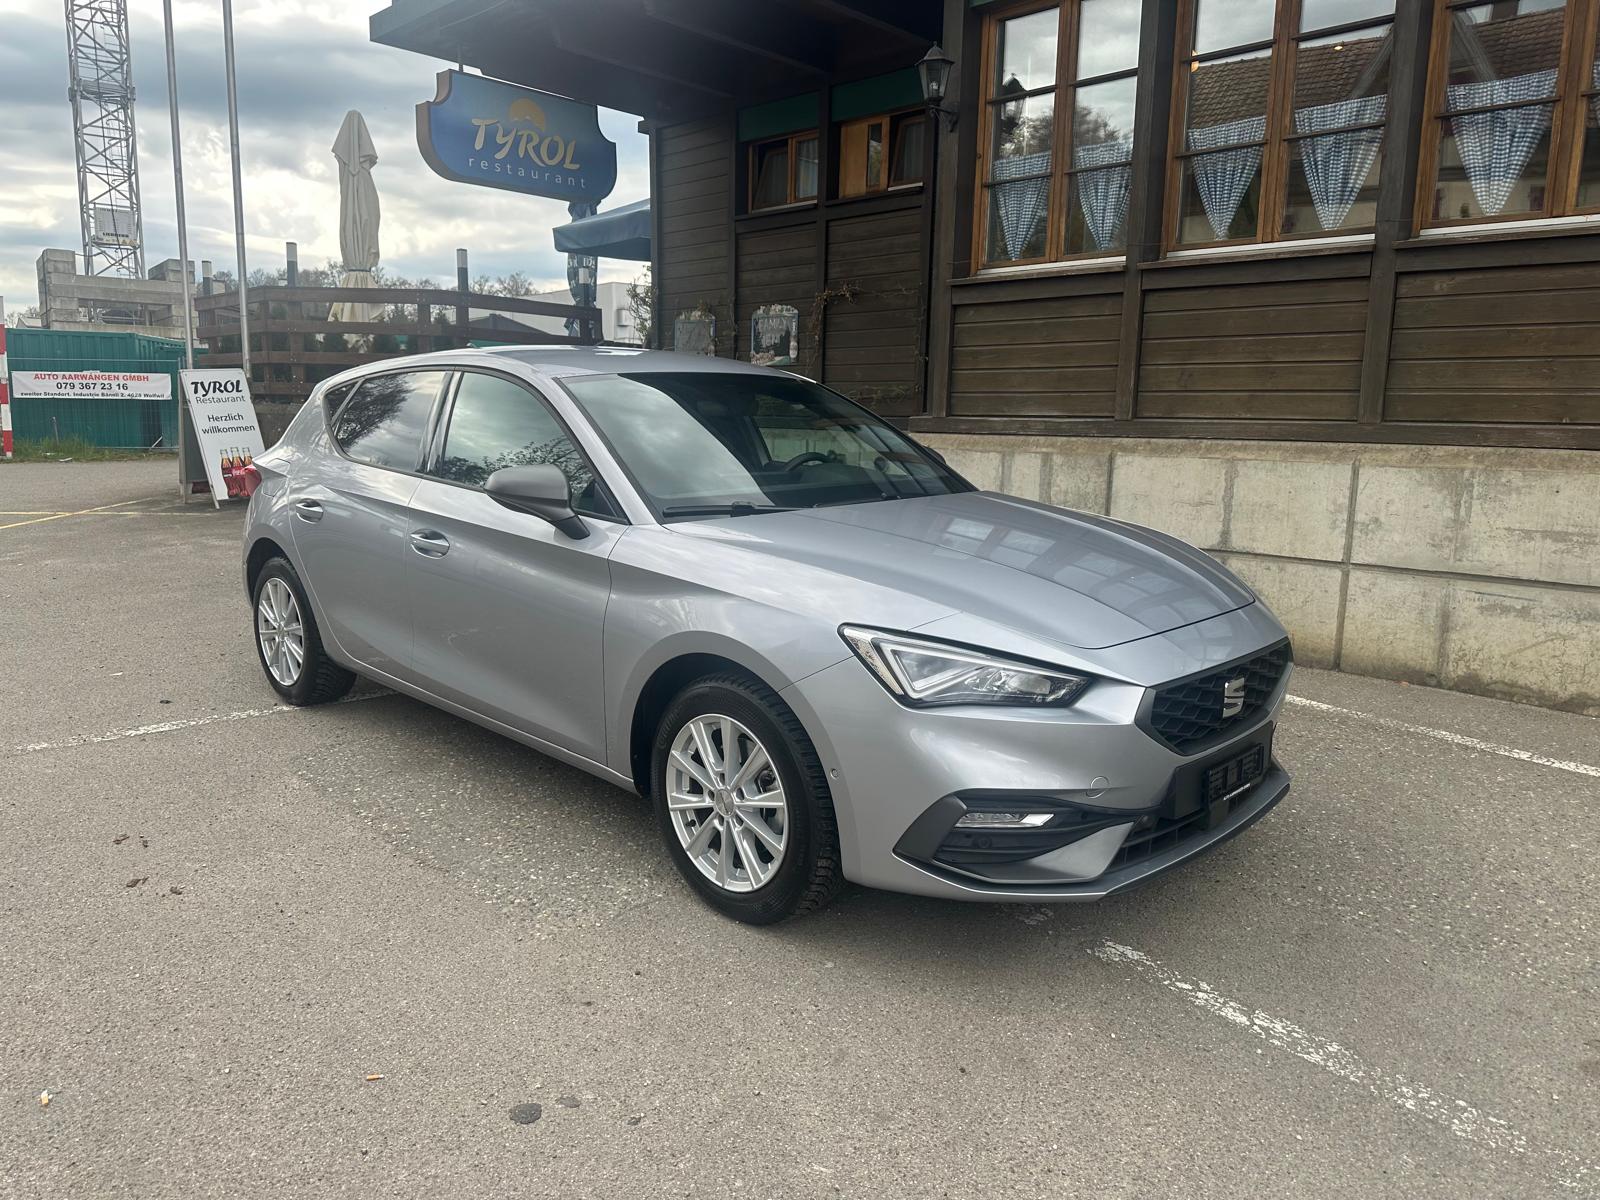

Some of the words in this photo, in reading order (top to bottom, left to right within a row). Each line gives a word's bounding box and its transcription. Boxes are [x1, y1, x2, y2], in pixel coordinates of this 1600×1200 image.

[471, 117, 581, 170] TYROL
[468, 156, 587, 189] restaurant
[33, 373, 59, 381] AUTO
[61, 373, 120, 382] AARWANGEN
[122, 374, 149, 382] GMBH
[56, 382, 76, 390] 079
[78, 382, 97, 390] 367
[100, 382, 113, 391] 23
[115, 383, 129, 391] 16
[191, 379, 243, 398] TYROL
[195, 395, 246, 405] Restaurant
[207, 412, 244, 423] Herzlich
[201, 424, 256, 435] willkommen
